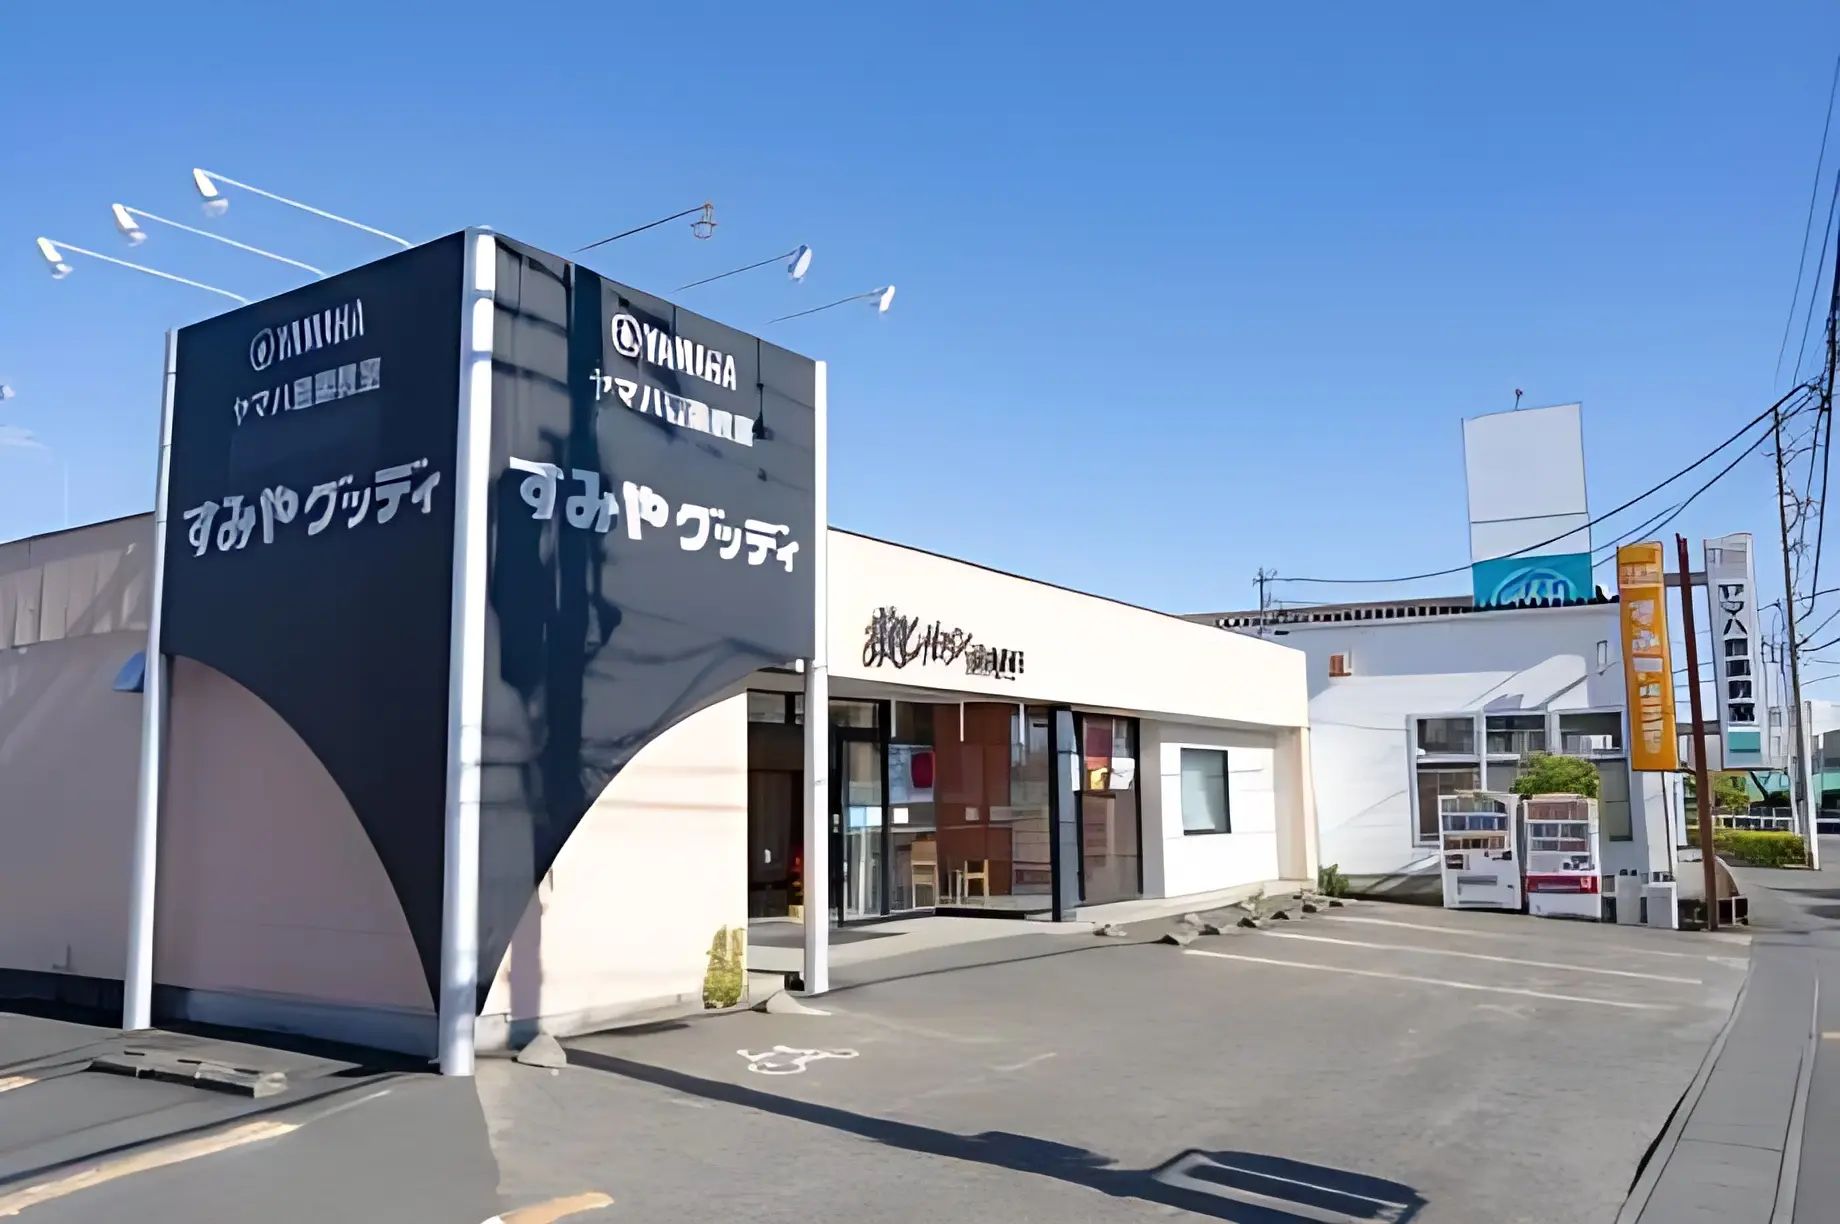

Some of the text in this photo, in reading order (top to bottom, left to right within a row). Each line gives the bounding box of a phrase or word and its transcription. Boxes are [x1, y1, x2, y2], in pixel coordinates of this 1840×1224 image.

[183, 457, 441, 558] すみやグッディ
[509, 456, 800, 573] すみやグッディ
